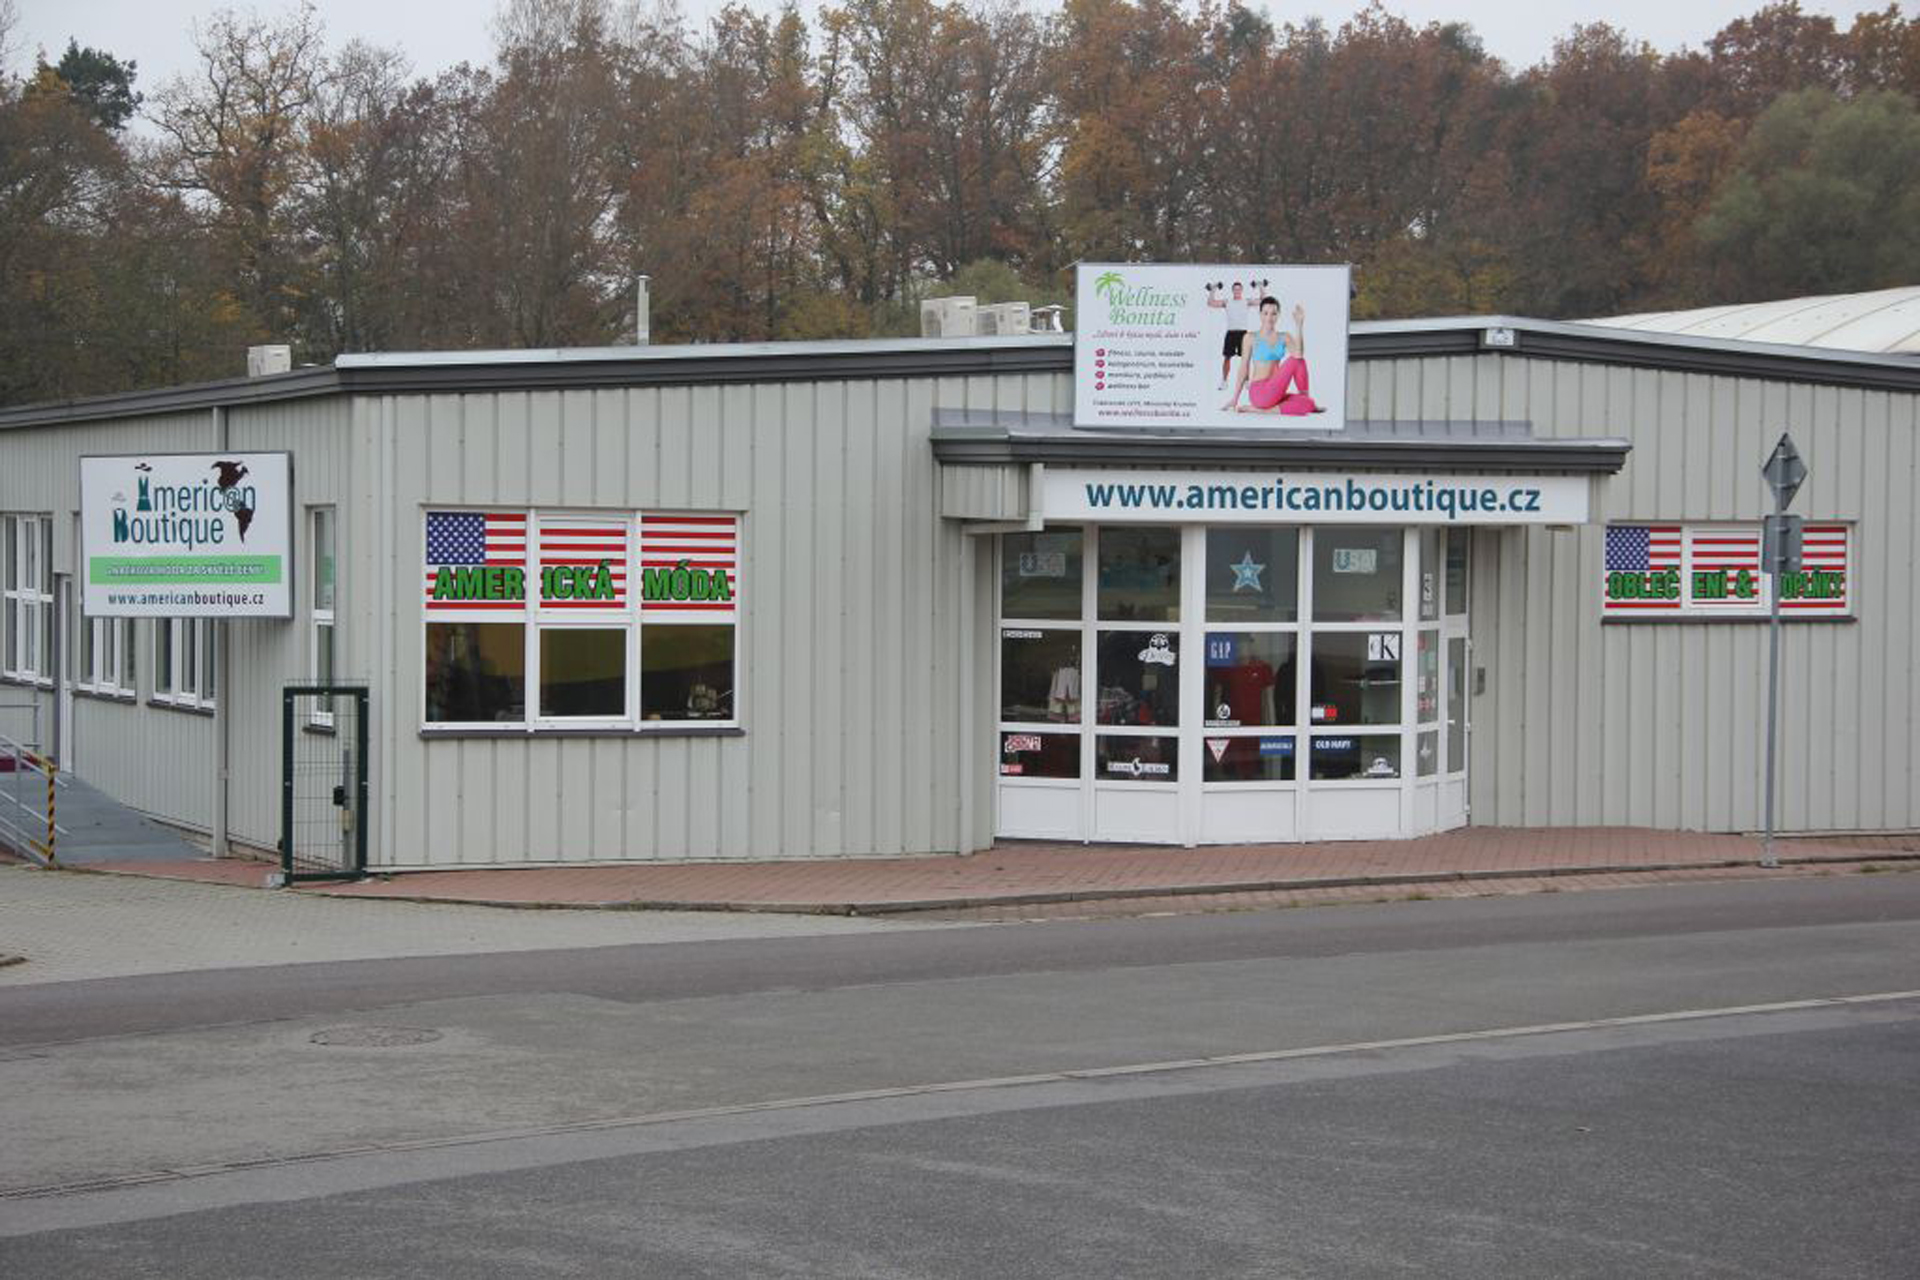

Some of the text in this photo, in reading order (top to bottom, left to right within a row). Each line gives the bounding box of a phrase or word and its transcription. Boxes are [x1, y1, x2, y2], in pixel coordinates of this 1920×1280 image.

[1109, 285, 1188, 307] Wellness
[1109, 308, 1176, 325] Bonita
[1086, 478, 1541, 519] www.americanboutique.cz
[113, 508, 224, 551] Boutique
[642, 559, 732, 601] MÓDA
[108, 591, 264, 608] www.americanboutique.cz
[1210, 641, 1231, 659] GAP
[1315, 740, 1330, 749] OLD
